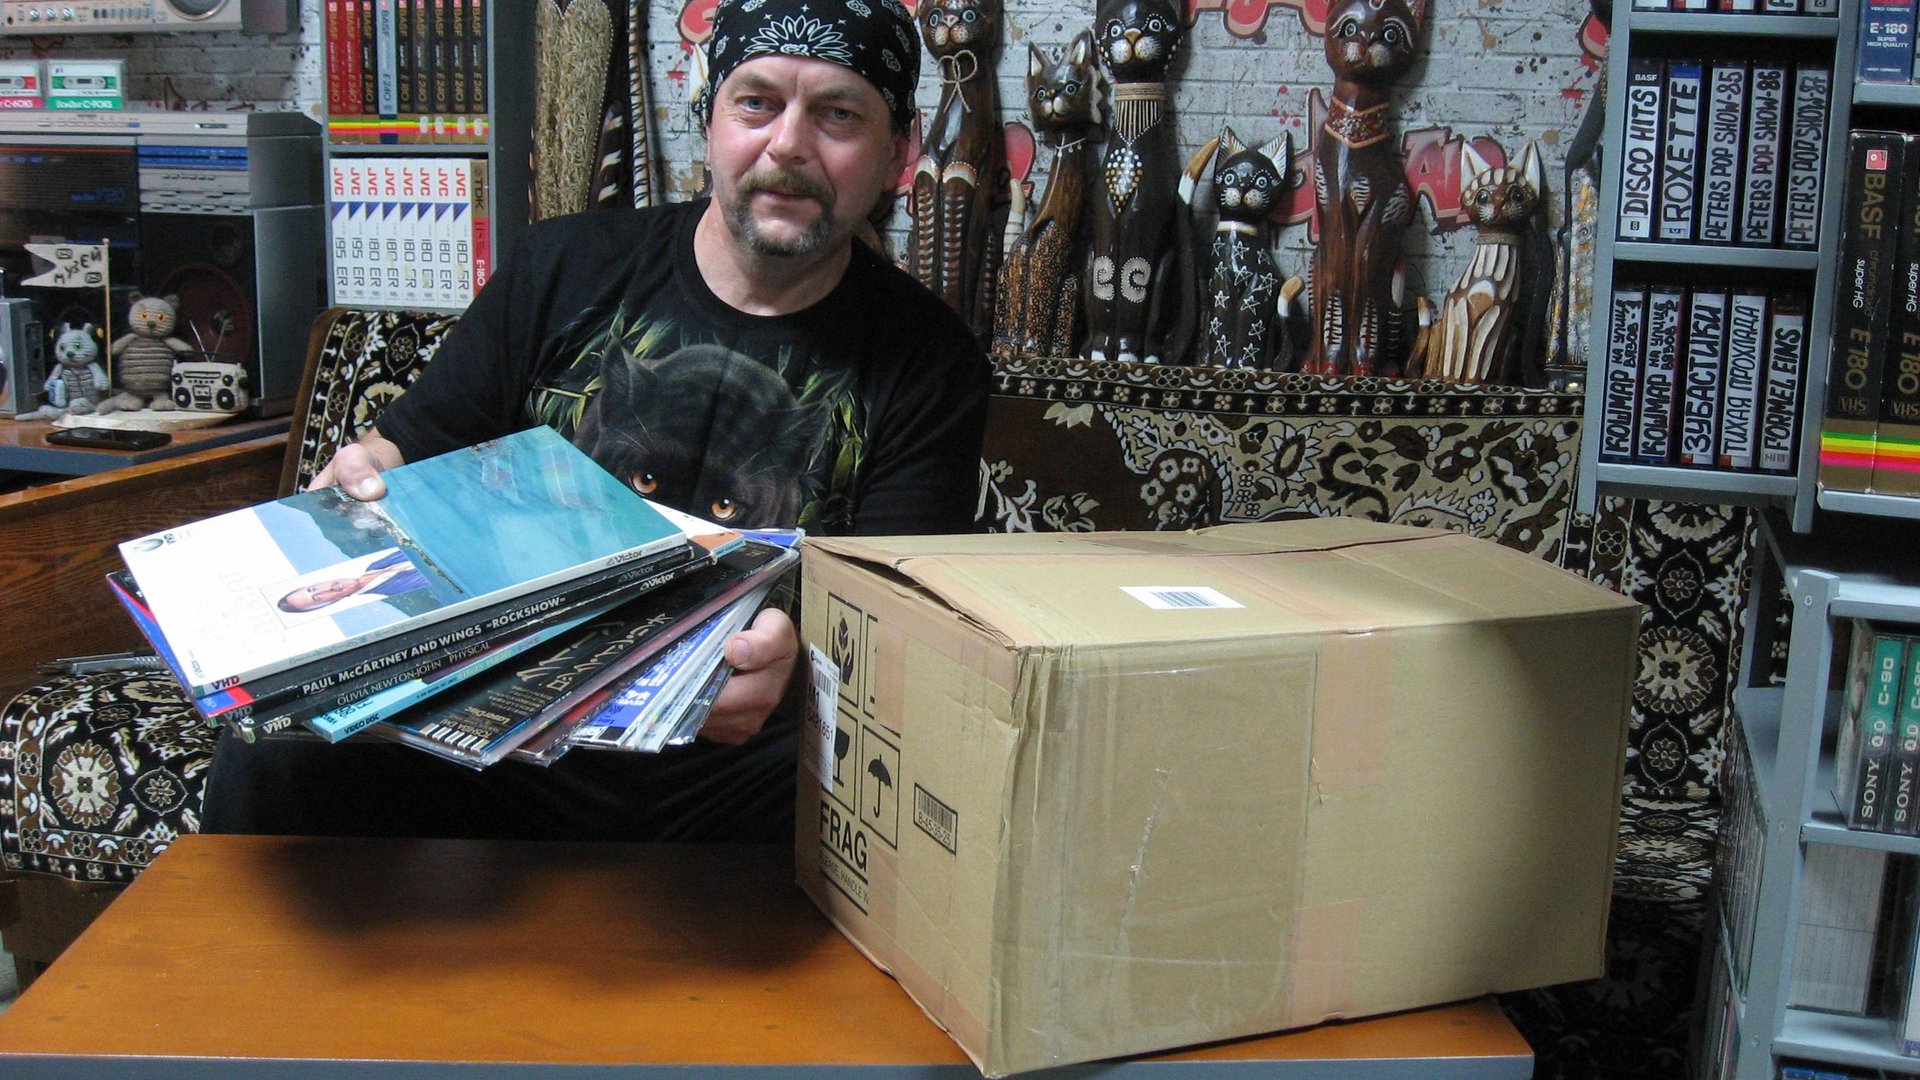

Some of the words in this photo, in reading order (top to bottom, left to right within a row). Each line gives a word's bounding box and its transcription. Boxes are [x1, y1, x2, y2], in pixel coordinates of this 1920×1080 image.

[330, 12, 338, 39] BASF
[346, 12, 354, 39] BASF
[363, 12, 372, 39] BASF
[416, 10, 425, 38] BASF
[435, 9, 444, 37] BASF
[454, 8, 462, 36] BASF
[472, 8, 481, 36] BASF
[1870, 23, 1907, 34] E-180
[1630, 89, 1658, 142] HITS
[1713, 71, 1743, 144] SHOW-85
[1663, 81, 1698, 223] ROXETTE
[1710, 147, 1733, 177] POP
[1752, 144, 1774, 175] POP
[1792, 139, 1819, 172] POP
[334, 168, 344, 196] JVC
[350, 167, 360, 196] JVC
[368, 168, 378, 196] JVC
[385, 167, 395, 196] JVC
[403, 168, 413, 196] JVC
[420, 168, 430, 196] JVC
[438, 168, 448, 196] JVC
[456, 168, 466, 196] JVC
[475, 179, 484, 209] TDK
[1623, 147, 1654, 215] DISCO
[1704, 180, 1731, 239] PETERS
[1746, 179, 1773, 240] PETERS
[1788, 175, 1817, 242] PETER'S
[1860, 173, 1886, 240] BASF
[335, 238, 346, 258] 195
[352, 238, 363, 258] 195
[369, 239, 380, 261] 180
[387, 239, 397, 261] 180
[404, 239, 415, 261] 180
[422, 239, 432, 262] 180
[440, 240, 450, 263] 180
[457, 240, 468, 263] 180
[54, 246, 102, 284] МУЗЕЙ
[336, 267, 347, 286] ER
[353, 267, 364, 286] ER
[370, 268, 381, 287] ER
[387, 268, 398, 288] ER
[477, 260, 486, 286] E-180
[1854, 259, 1866, 289] super
[1907, 262, 1919, 294] super
[440, 270, 452, 289] ER
[1853, 290, 1863, 309] HG
[1906, 294, 1917, 313] HG
[1729, 305, 1760, 392] ПРОХЛАДА
[1850, 328, 1871, 344] E
[1903, 332, 1920, 349] E
[1771, 327, 1801, 375] EINS
[1684, 304, 1722, 453] ЗУБАСТИКИ
[1845, 348, 1869, 390] 180
[1898, 352, 1920, 395] 180
[1605, 369, 1635, 452] КОШМАР
[1641, 374, 1671, 455] КОШМАР
[1764, 379, 1796, 451] FORMEL
[1841, 398, 1867, 411] VHS
[1893, 402, 1919, 416] VHS
[1724, 396, 1752, 454] ТИХАЯ
[614, 550, 642, 563] Victor
[629, 565, 654, 579] Victor
[649, 572, 675, 588] Victor
[302, 674, 335, 695] PAUL
[338, 651, 408, 682] McCARTNEY
[410, 640, 438, 656] AND
[438, 624, 482, 646] WINGS
[516, 621, 625, 681] クイーン
[211, 675, 240, 690] VHD
[337, 689, 369, 706] OLIVIA
[370, 660, 441, 693] NEWTON-JOHN
[449, 641, 491, 664] PHYSICAL
[223, 705, 253, 720] VHD
[263, 717, 292, 734] VHD
[344, 717, 365, 735] VIDEO
[364, 713, 379, 727] DISC
[463, 704, 512, 724] LaserDisc
[454, 722, 494, 738] TOSHIBA
[1862, 758, 1880, 818] SONY
[1878, 658, 1895, 705] C-90
[1895, 762, 1913, 822] SONY
[840, 871, 863, 898] HANDLE
